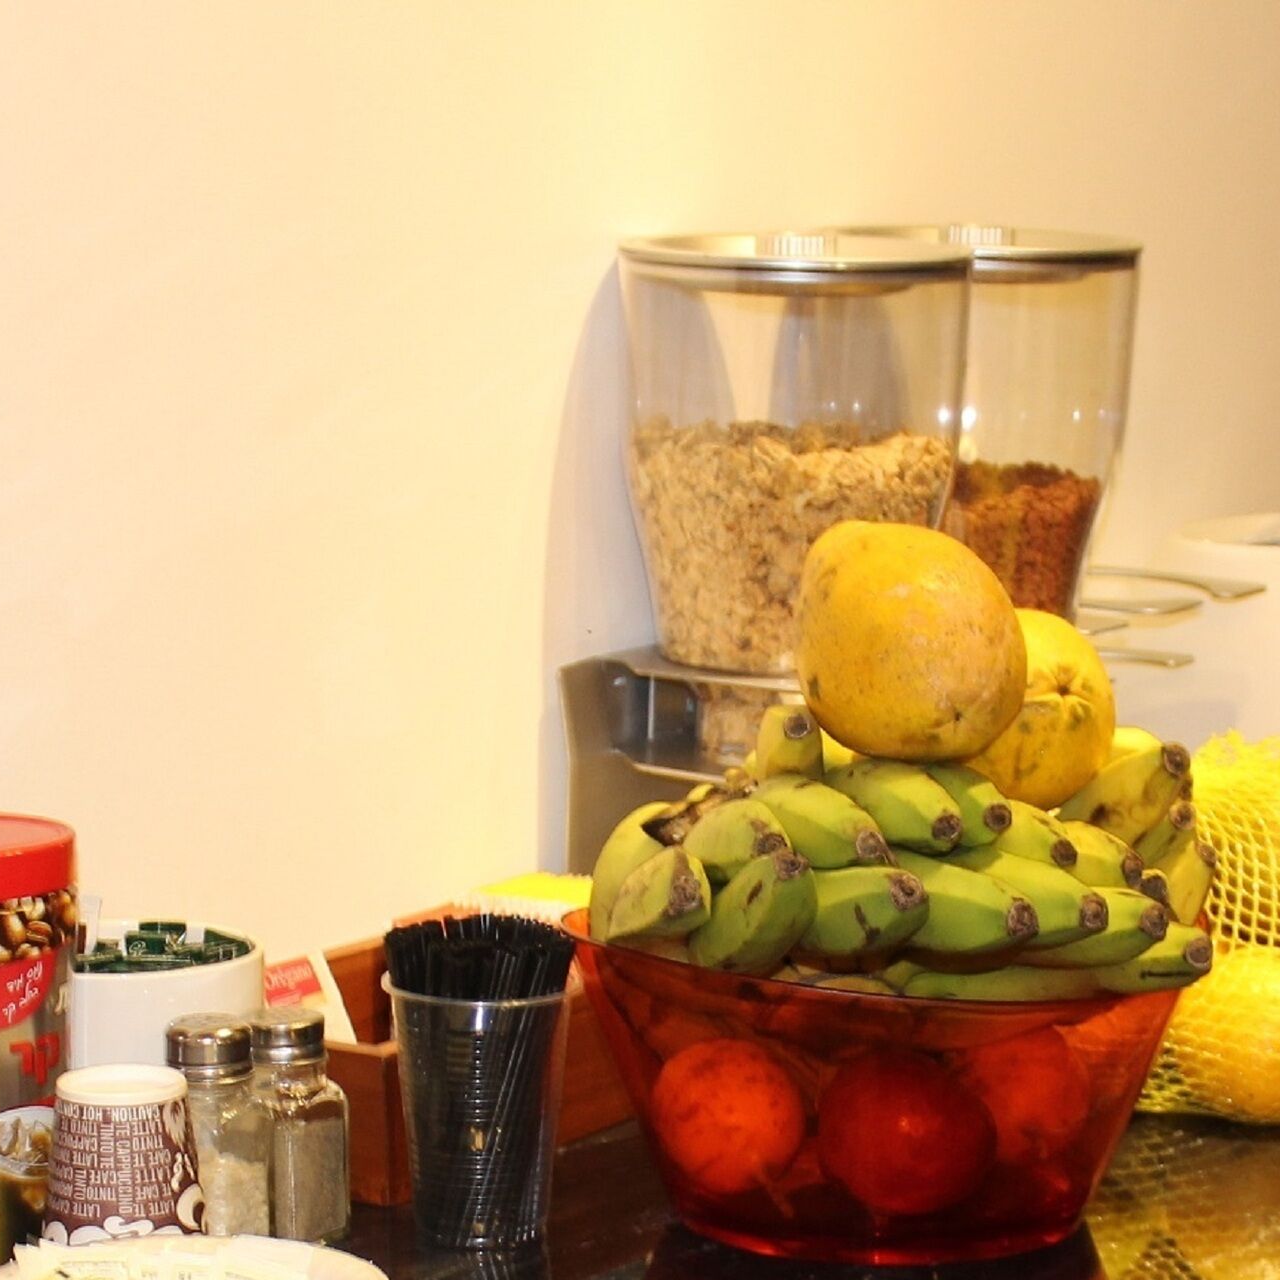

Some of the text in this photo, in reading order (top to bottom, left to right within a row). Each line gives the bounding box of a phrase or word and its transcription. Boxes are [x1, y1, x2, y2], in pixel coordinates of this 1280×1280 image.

[82, 1105, 103, 1122] HOT
[70, 1118, 98, 1136] TINTO
[131, 1118, 163, 1136] LATTE
[100, 1122, 114, 1153] TINTO
[132, 1135, 164, 1152] TINTO
[72, 1150, 98, 1168] LATTE
[115, 1139, 133, 1214] CAPPUCCINO
[134, 1165, 171, 1184] LATTE
[73, 1169, 87, 1201] TINTO
[86, 1185, 117, 1202] TINTO
[72, 1201, 100, 1219] LATTE
[148, 1199, 175, 1217] LATTE
